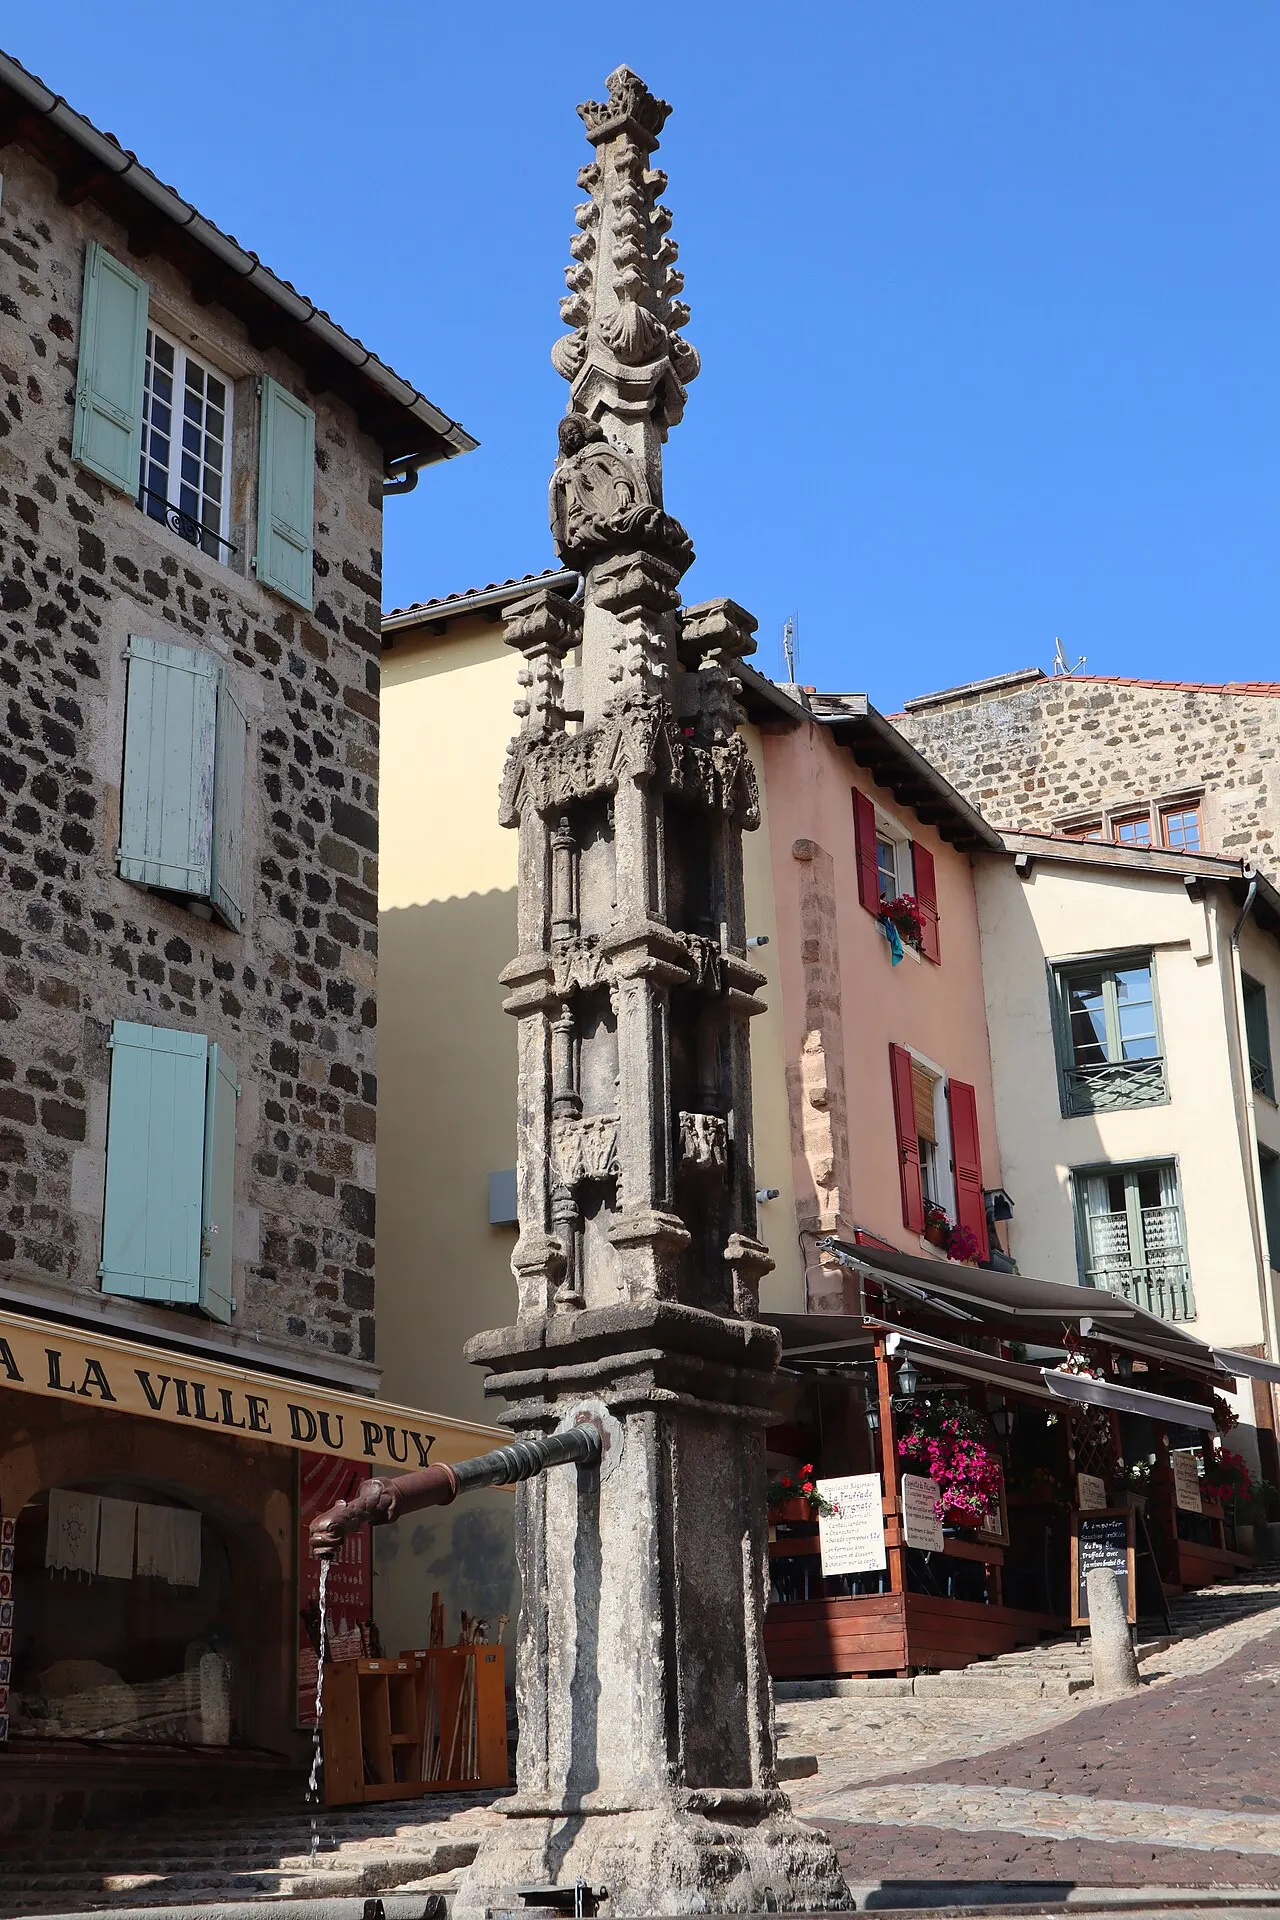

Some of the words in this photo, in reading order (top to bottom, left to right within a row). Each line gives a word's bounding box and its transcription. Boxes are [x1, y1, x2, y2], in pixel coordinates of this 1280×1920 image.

[0, 1337, 25, 1382] A
[44, 1348, 117, 1402] LA
[133, 1368, 272, 1434] VILLE
[286, 1403, 344, 1449] DU
[360, 1419, 436, 1468] PUY
